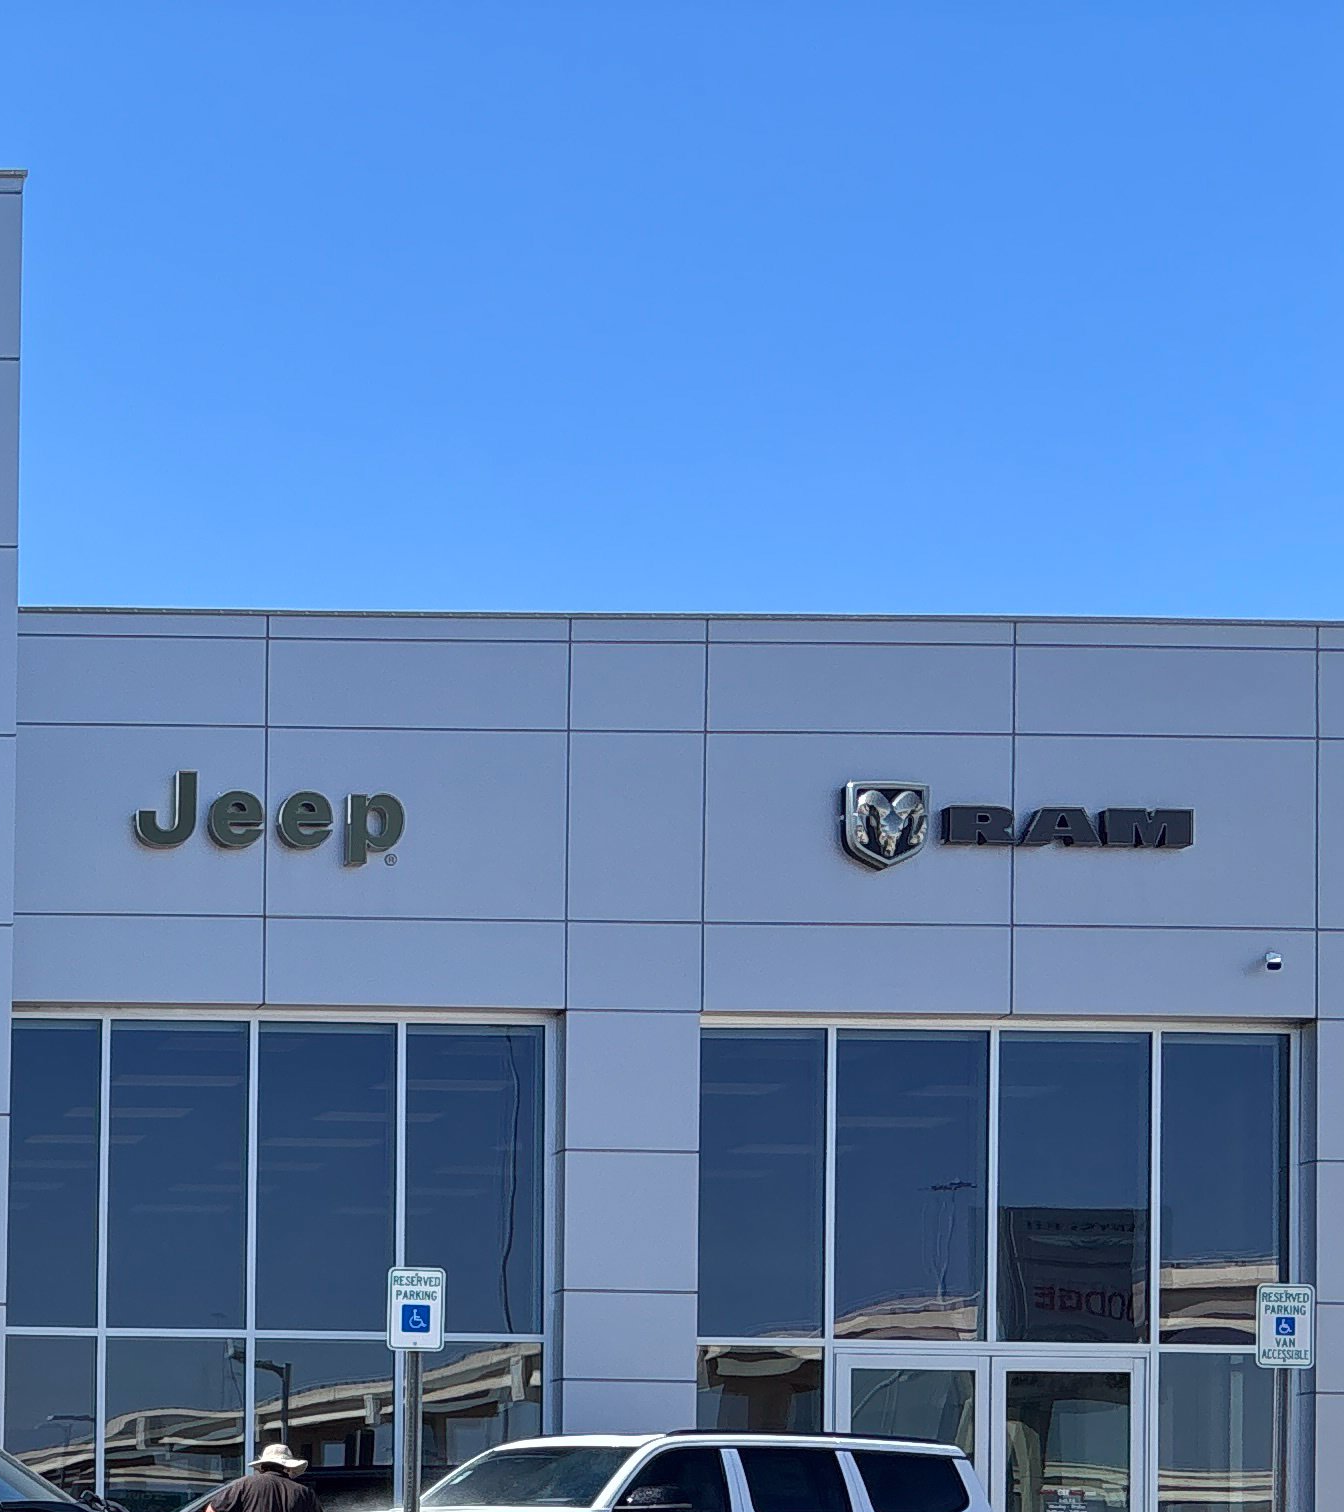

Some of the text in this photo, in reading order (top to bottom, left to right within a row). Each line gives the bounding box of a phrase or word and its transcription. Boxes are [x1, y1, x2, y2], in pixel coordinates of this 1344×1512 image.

[134, 769, 406, 867] Jeep
[940, 804, 1195, 849] RAM
[393, 1275, 441, 1287] RESERVED
[395, 1289, 438, 1301] PARKING
[1261, 1292, 1310, 1303] RESERVED
[1264, 1304, 1307, 1315] PARKING
[1275, 1338, 1296, 1348] VAN
[1261, 1349, 1309, 1360] ACCESSIBLE
